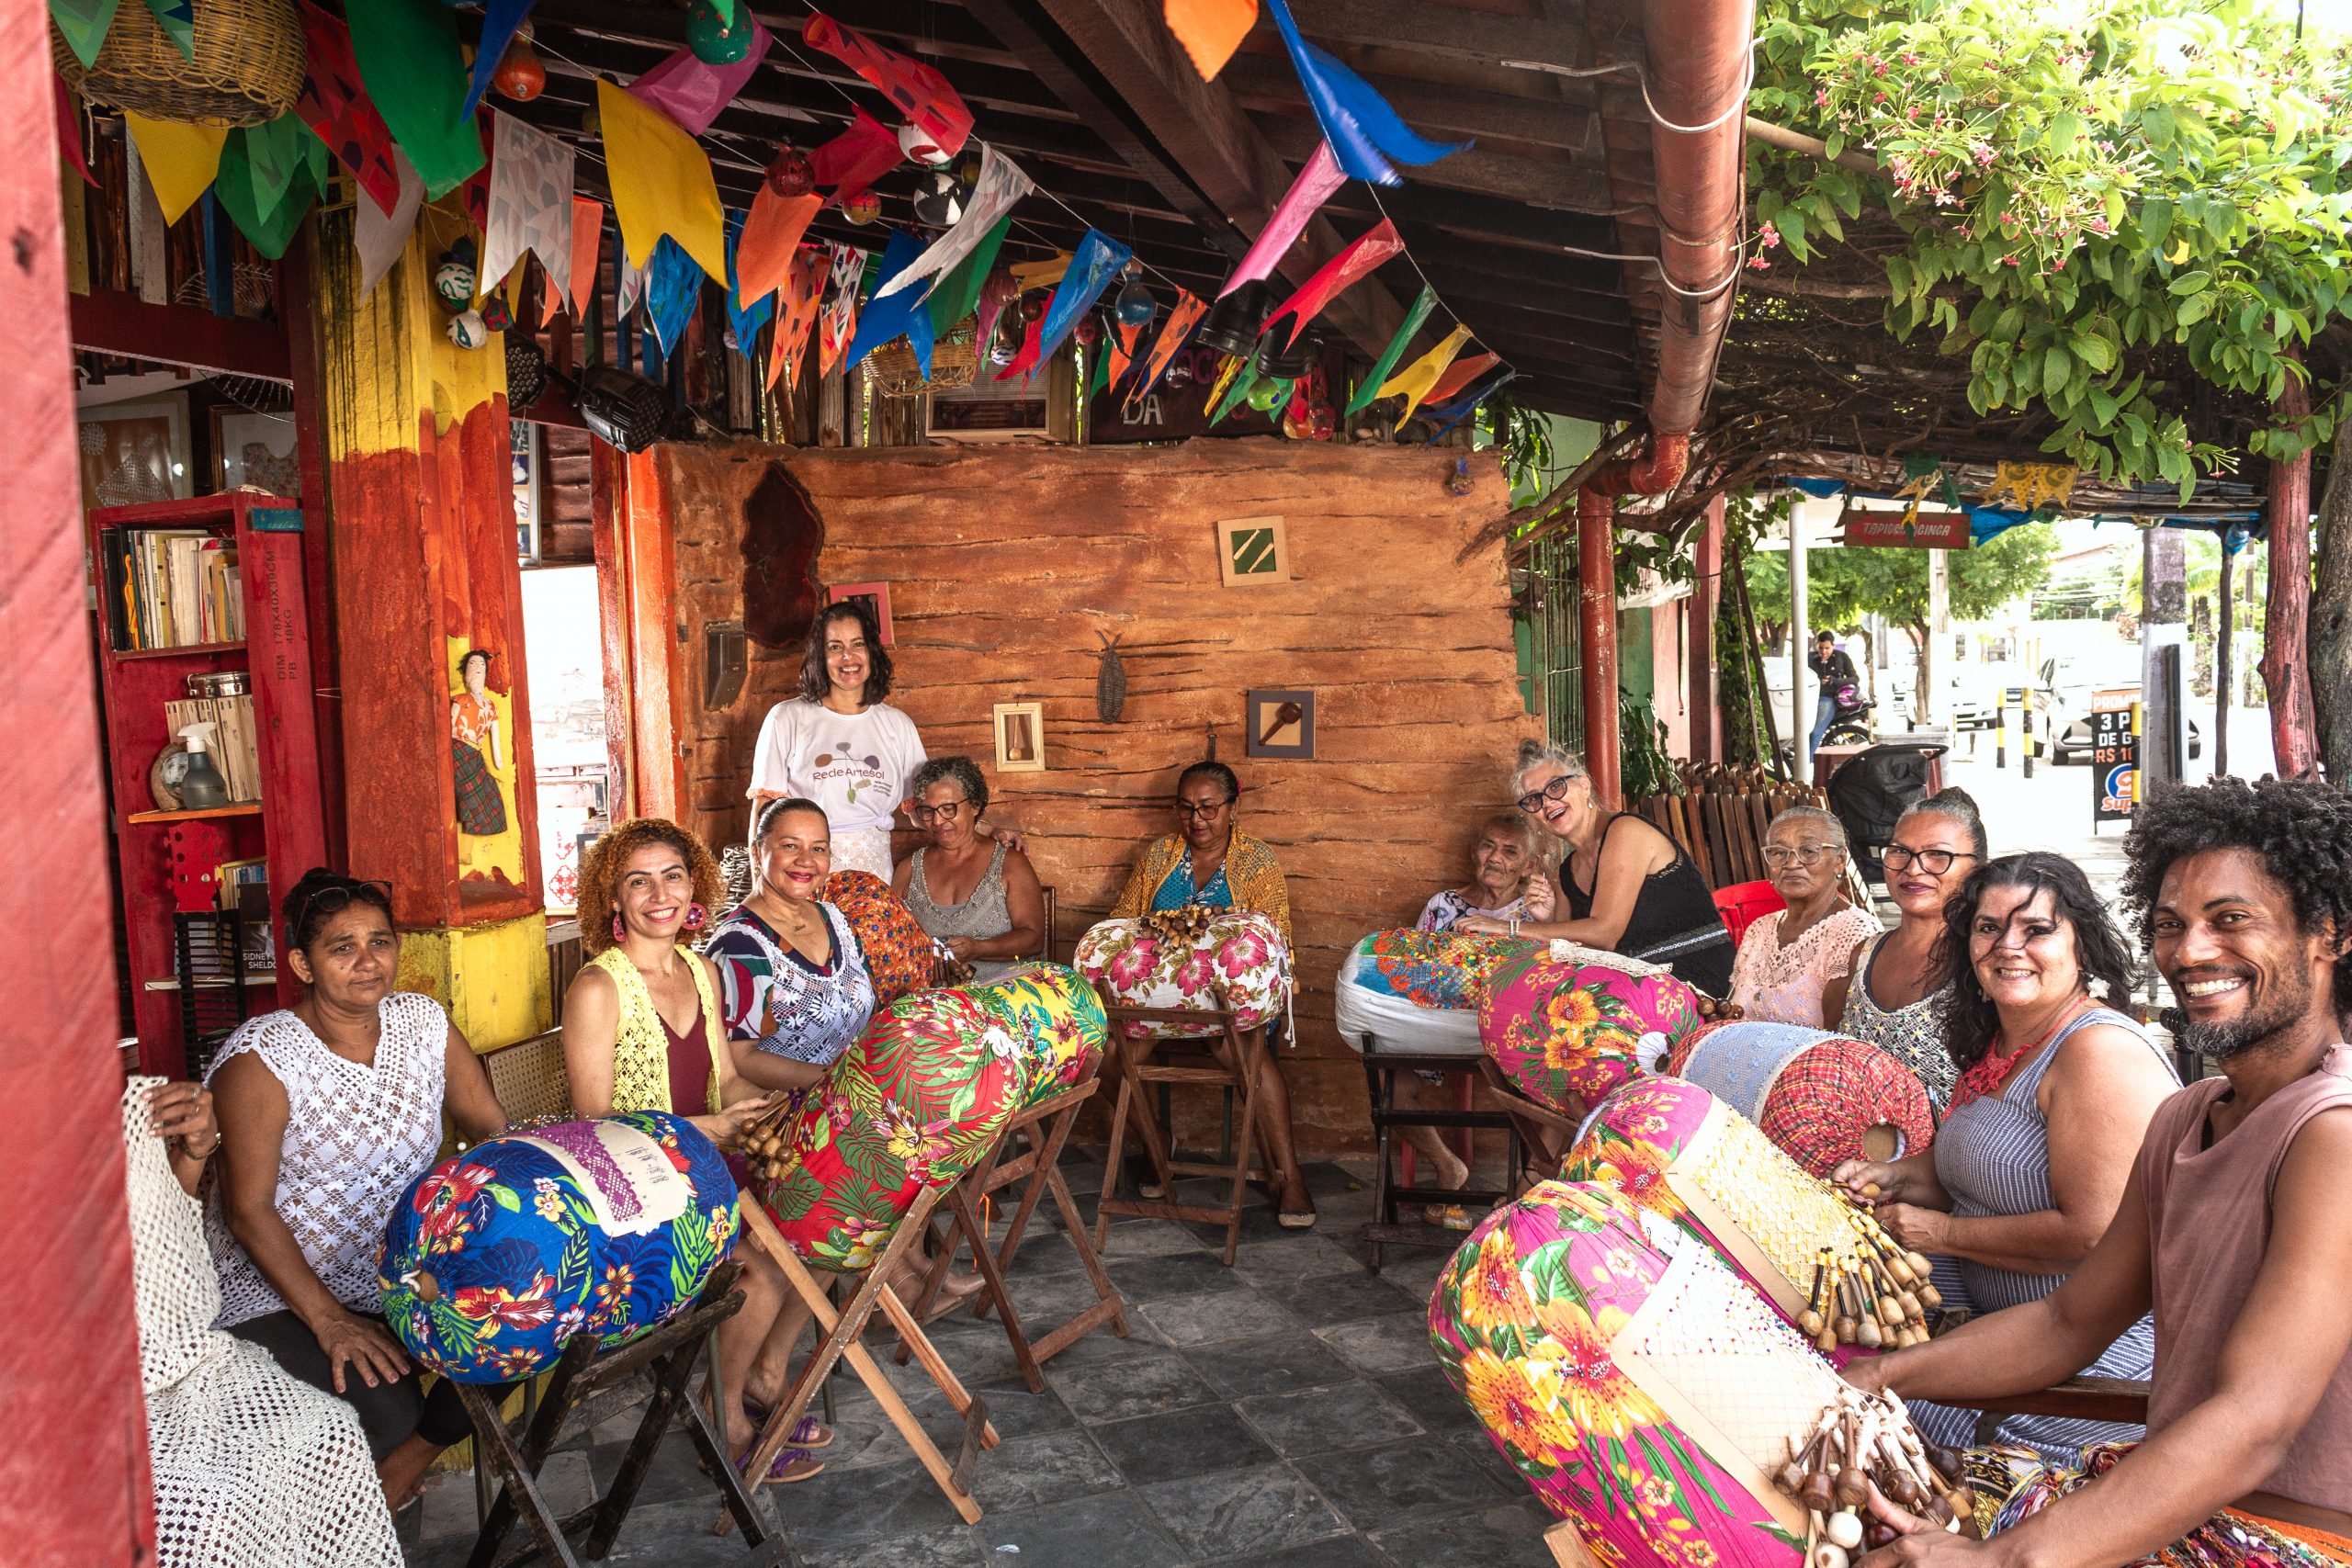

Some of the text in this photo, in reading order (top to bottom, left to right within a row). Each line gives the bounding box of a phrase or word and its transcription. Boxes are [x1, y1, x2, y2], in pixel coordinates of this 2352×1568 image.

[1123, 393, 1163, 425] DA
[283, 609, 298, 680] PB 48KG
[277, 655, 287, 680] DIM
[2101, 712, 2132, 730] 3 P
[2098, 731, 2132, 747] DE G
[813, 767, 885, 780] Rede Artesol
[2101, 795, 2132, 814] Sup
[243, 953, 270, 961] SIDNEY
